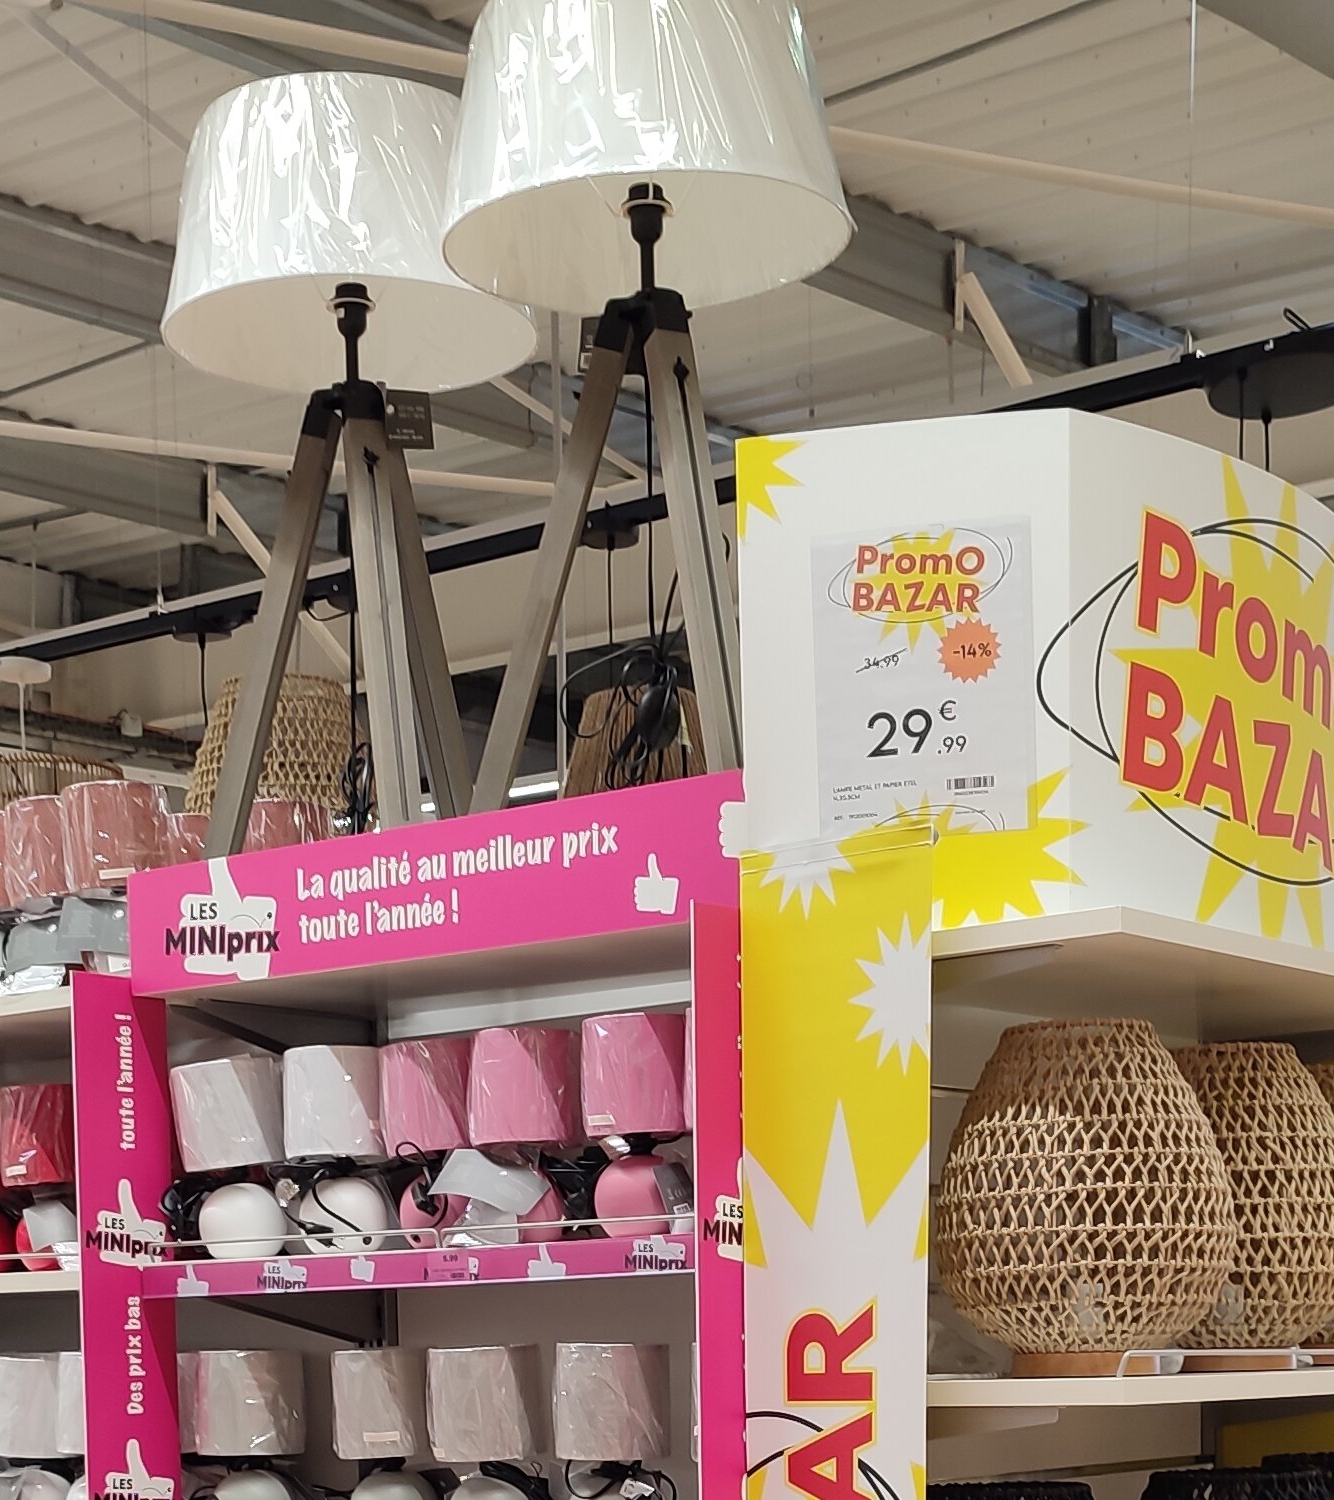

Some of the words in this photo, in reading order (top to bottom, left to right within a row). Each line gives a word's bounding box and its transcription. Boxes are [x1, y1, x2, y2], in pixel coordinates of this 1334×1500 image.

[852, 581, 980, 613] BAZAR
[953, 642, 992, 660] -14%
[867, 707, 933, 758] 29
[296, 868, 325, 901] La
[330, 849, 411, 901] qualité
[417, 853, 446, 883] au
[452, 833, 555, 879] meilleur
[562, 821, 619, 869] prix
[189, 902, 219, 921] LES
[298, 912, 360, 944] toute
[119, 1094, 137, 1151] toute
[104, 1217, 125, 1231] LES
[638, 1243, 654, 1254] LES
[123, 1295, 141, 1331] bas
[124, 1334, 147, 1379] prix
[127, 1382, 145, 1416] Des
[112, 1477, 134, 1491] LES
